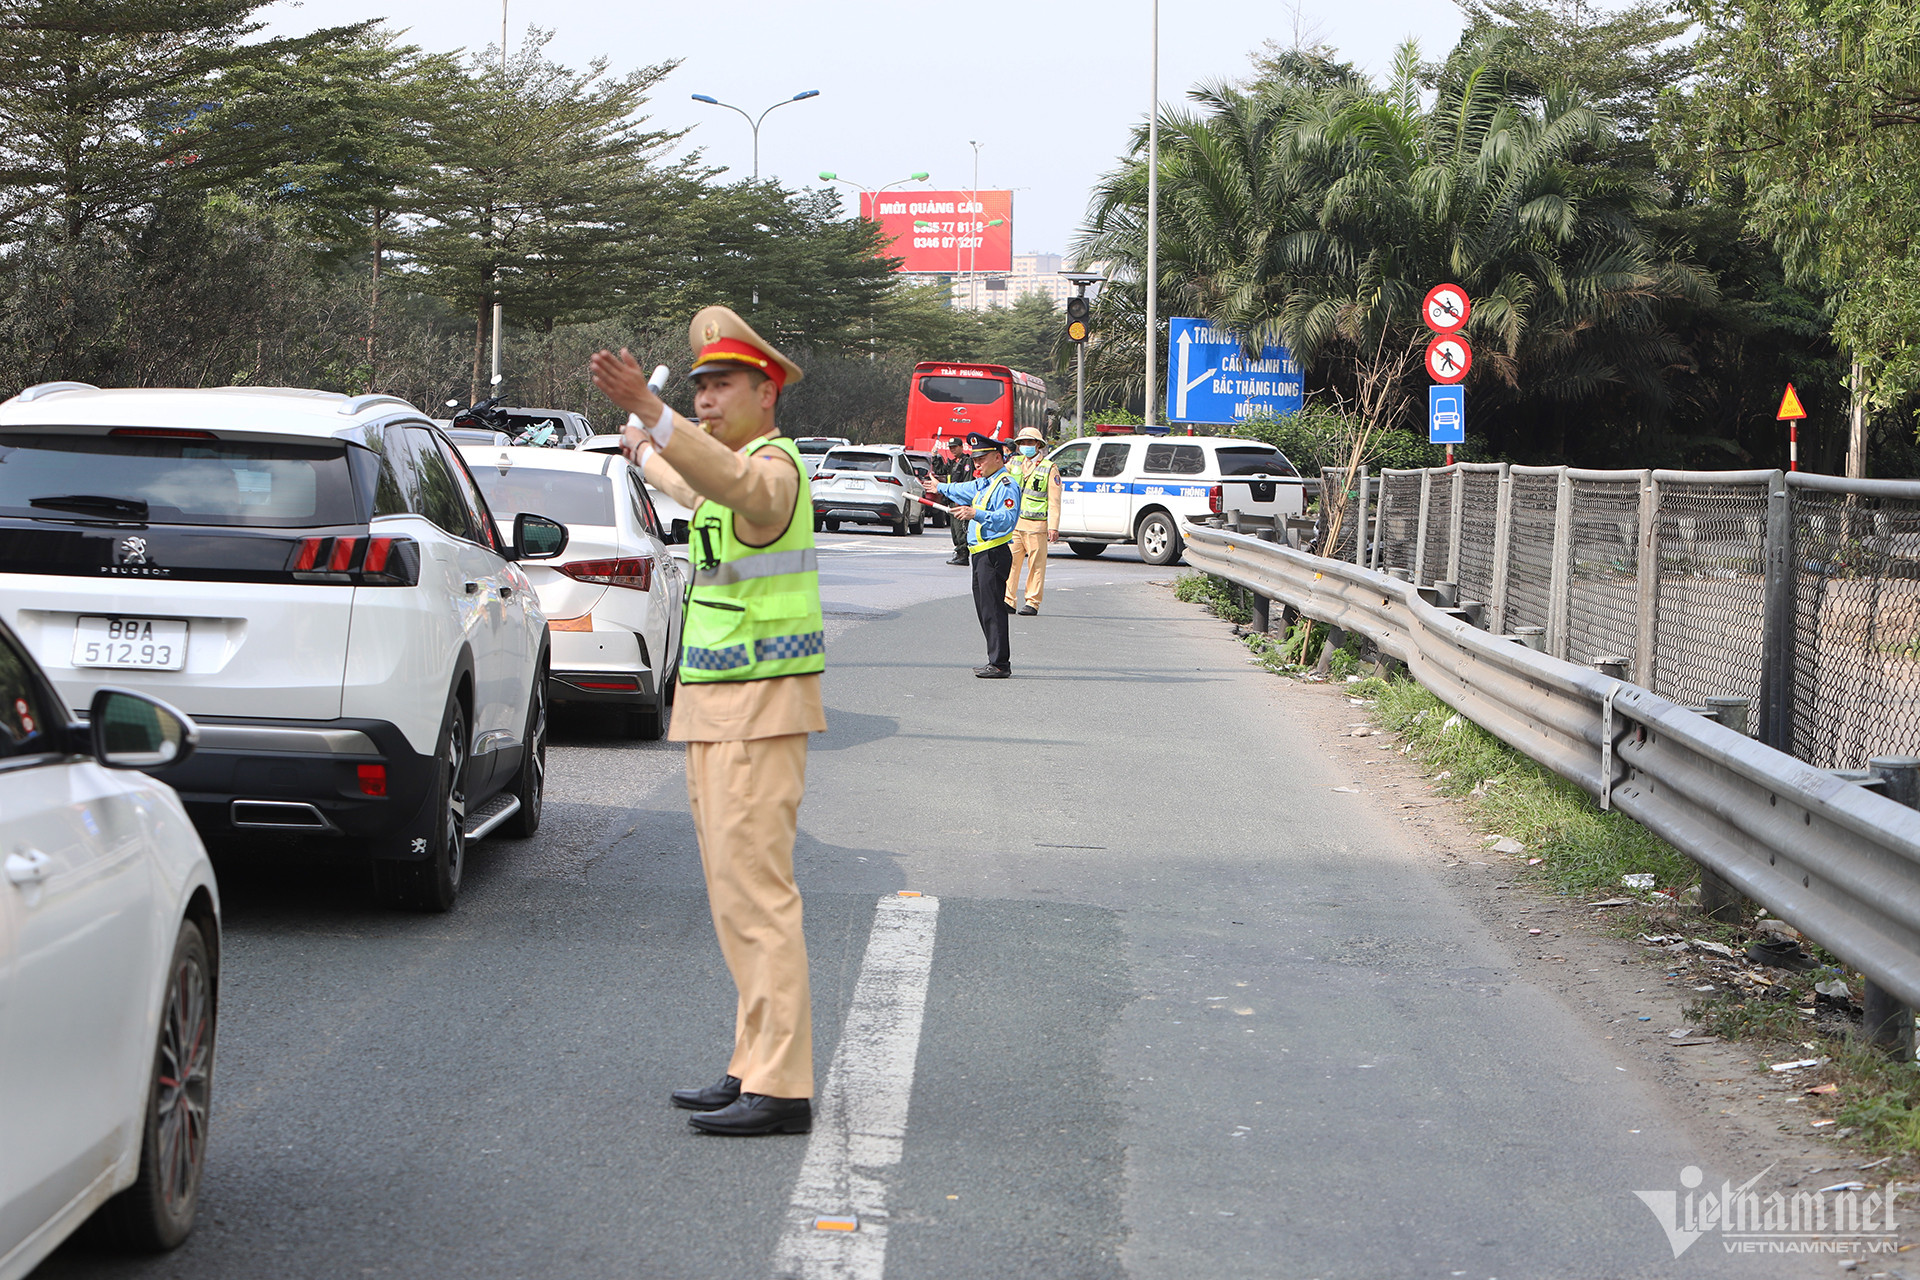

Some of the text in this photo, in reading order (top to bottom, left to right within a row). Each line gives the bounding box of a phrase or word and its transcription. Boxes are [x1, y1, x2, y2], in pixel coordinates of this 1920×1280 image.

[880, 200, 983, 215] MỜI QUẢNG CÁO
[942, 222, 955, 233] 77
[1221, 353, 1242, 372] CẦU
[1245, 358, 1280, 373] THANH
[941, 367, 957, 376] TRẦN
[1212, 374, 1299, 397] BẮC THĂNG LONG
[1095, 483, 1110, 493] SÁT
[1180, 486, 1206, 497] THÔNG
[101, 566, 171, 576] PEUGEOT
[108, 620, 153, 641] 88A
[85, 642, 171, 665] 512.93
